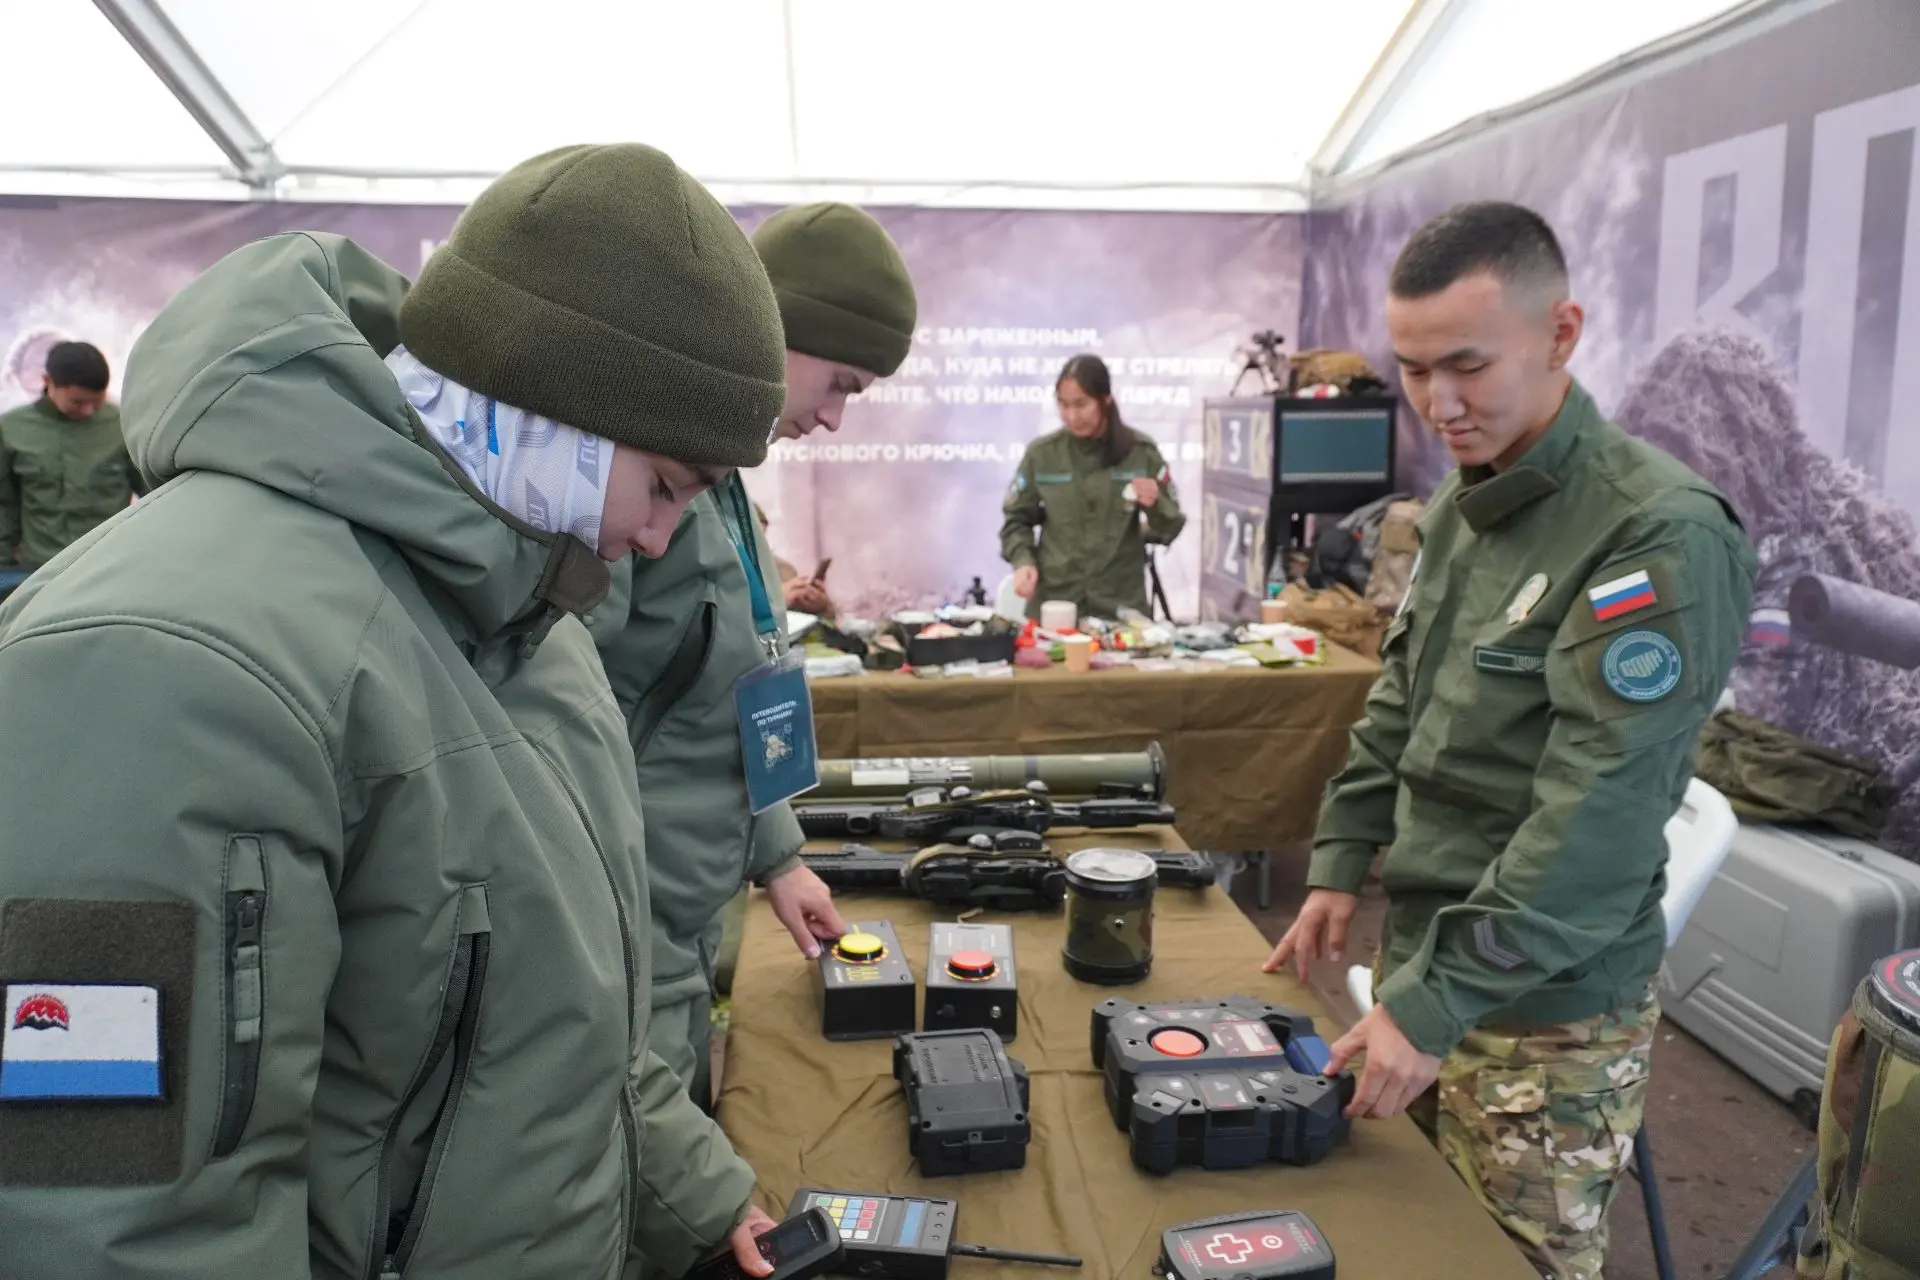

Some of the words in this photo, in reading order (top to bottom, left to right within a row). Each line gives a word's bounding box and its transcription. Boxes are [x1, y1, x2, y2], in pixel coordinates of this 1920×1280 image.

[916, 327, 931, 345] С
[945, 357, 1004, 376] КУДА
[1008, 357, 1037, 375] НЕ
[936, 386, 978, 403] ЧТО
[1228, 420, 1242, 464] 3
[1224, 512, 1240, 574] 2
